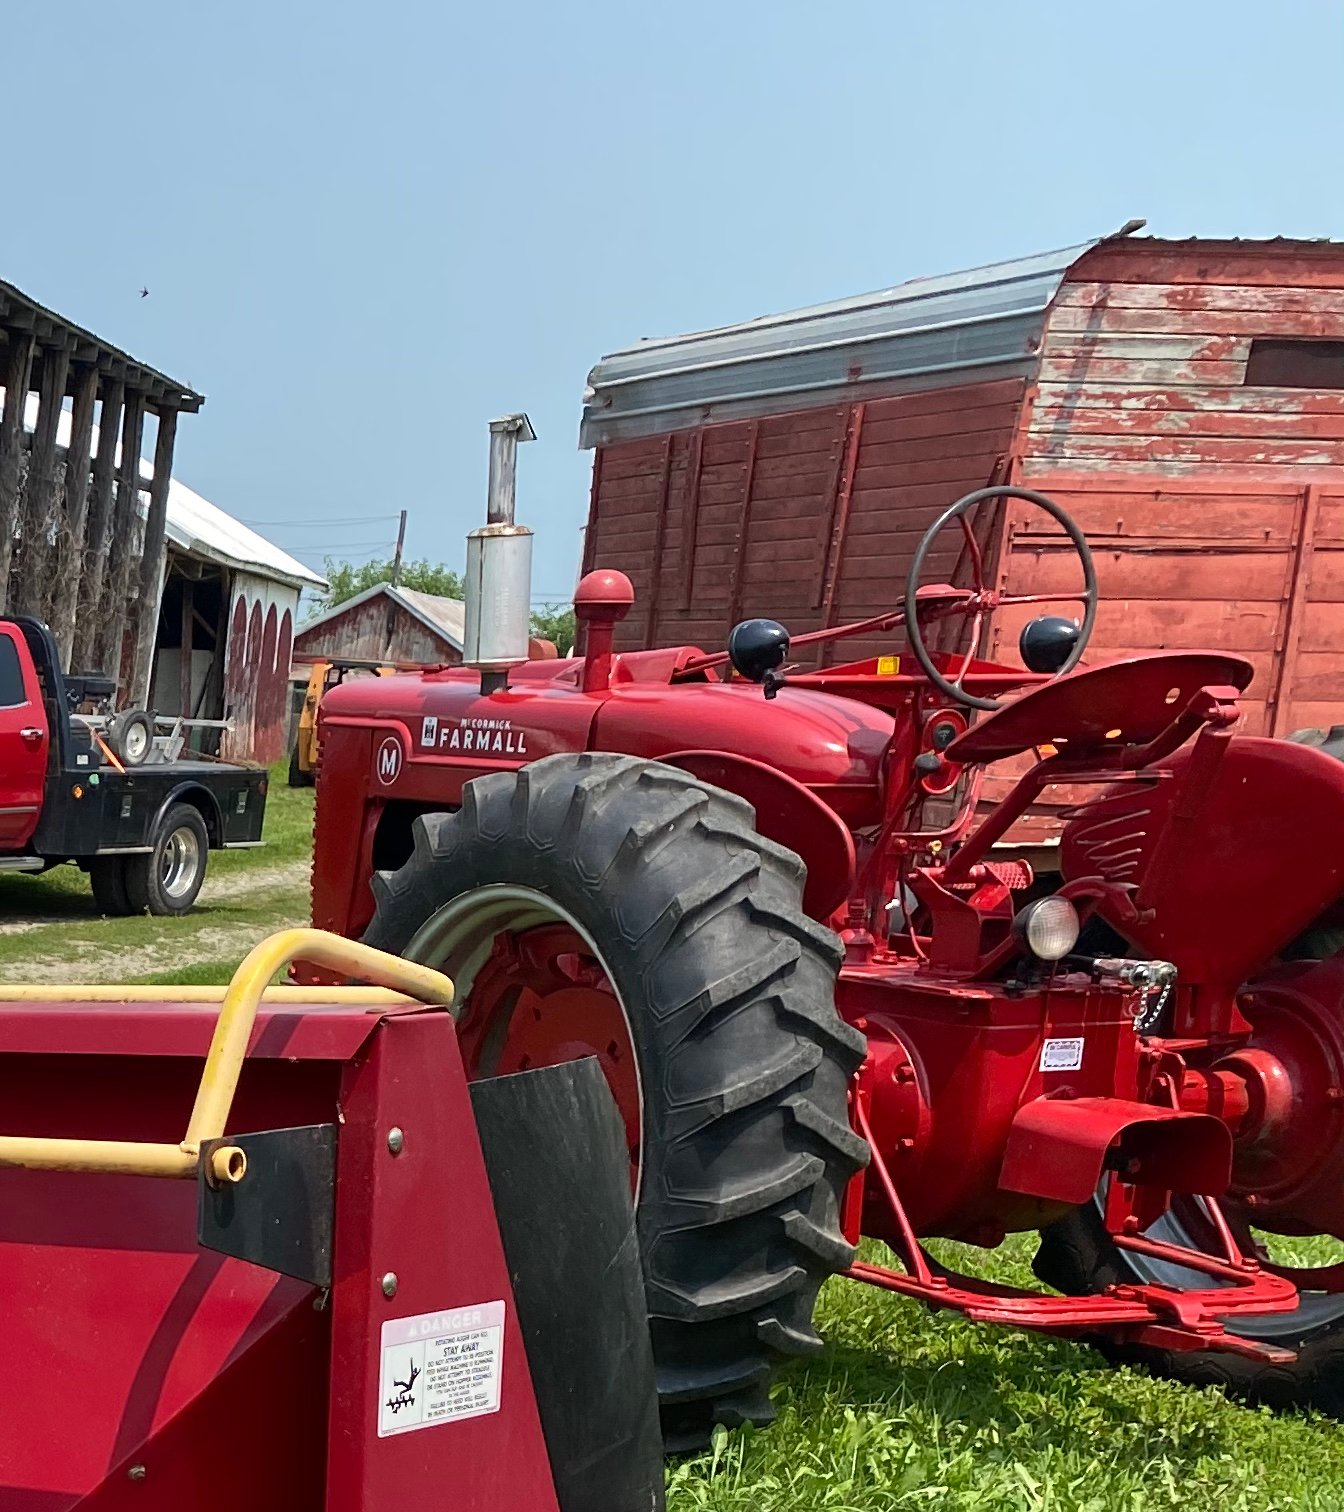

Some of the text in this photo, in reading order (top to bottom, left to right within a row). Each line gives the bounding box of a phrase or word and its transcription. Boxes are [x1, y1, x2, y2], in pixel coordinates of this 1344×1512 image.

[439, 728, 527, 753] FARMALL
[380, 748, 397, 776] M
[420, 1310, 482, 1334] DANGER
[443, 1342, 480, 1357] STAY AWAY
